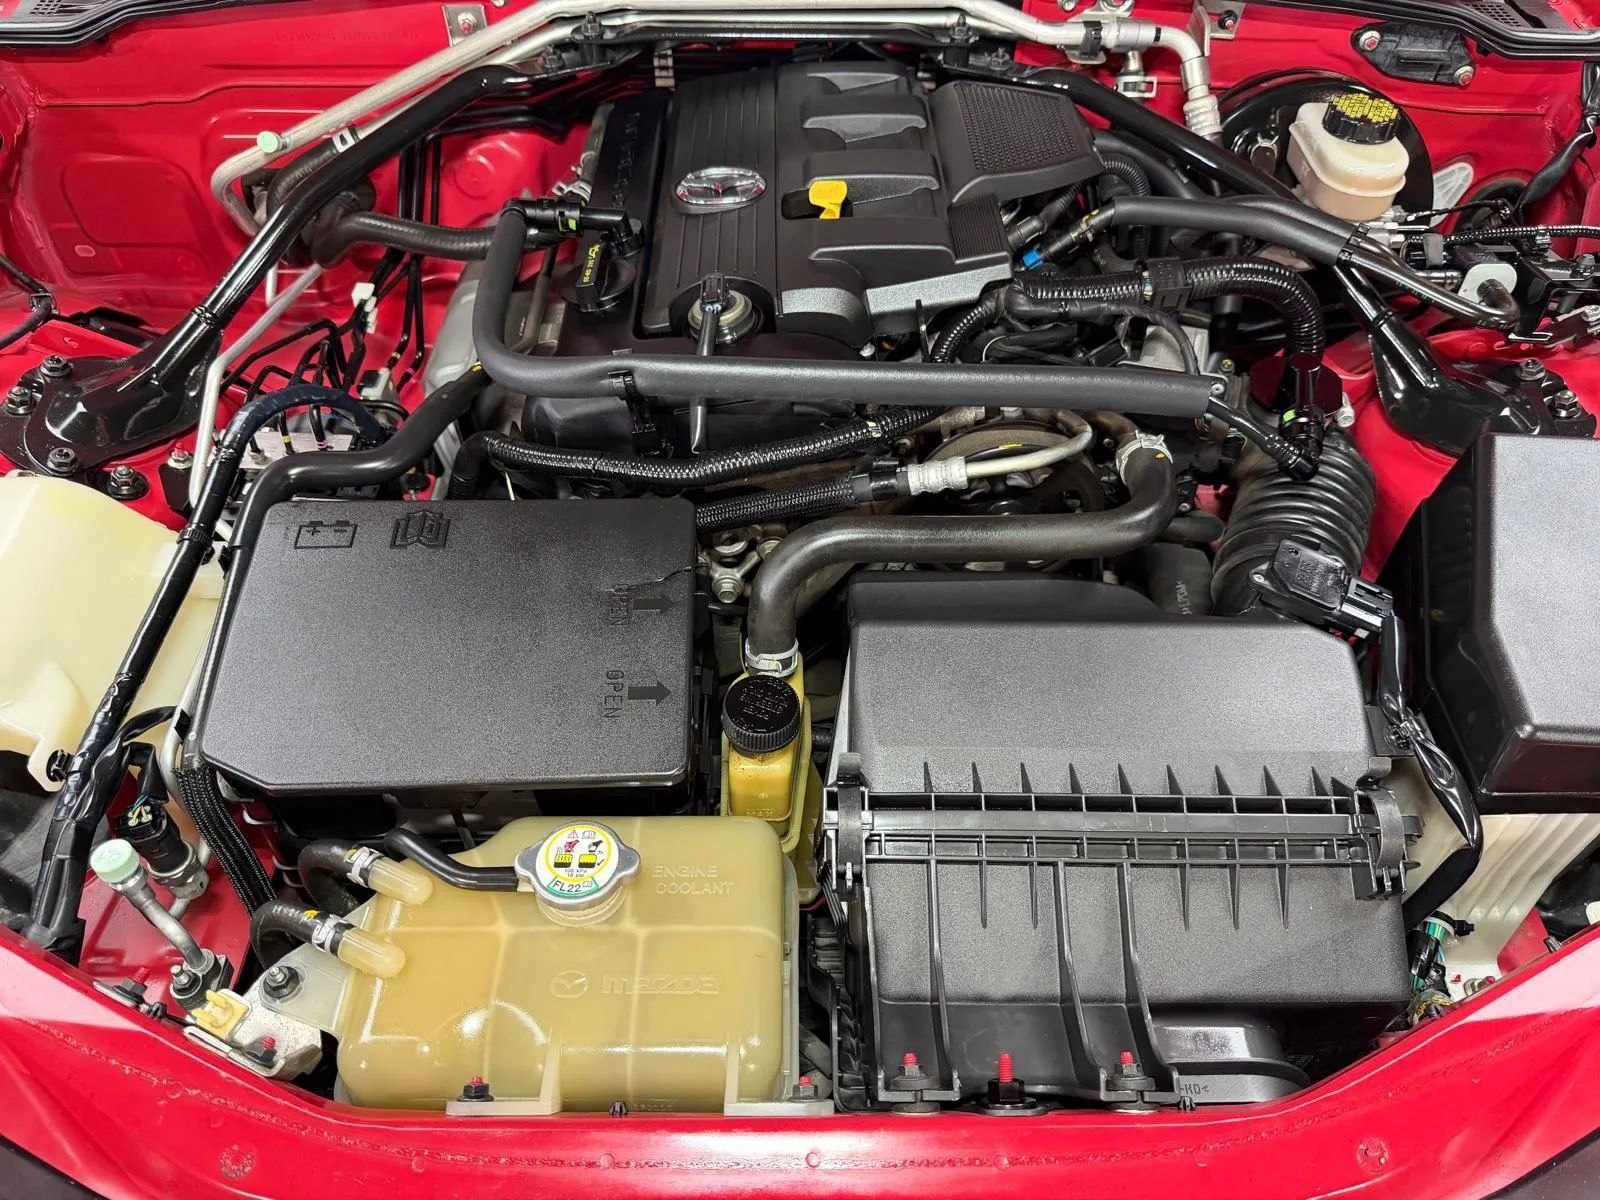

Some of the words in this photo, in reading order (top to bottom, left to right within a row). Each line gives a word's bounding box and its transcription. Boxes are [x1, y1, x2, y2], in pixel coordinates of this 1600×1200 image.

[603, 669, 625, 718] OPEN
[653, 864, 719, 878] ENGINE
[552, 880, 582, 892] FL22
[655, 881, 735, 895] COOLANT
